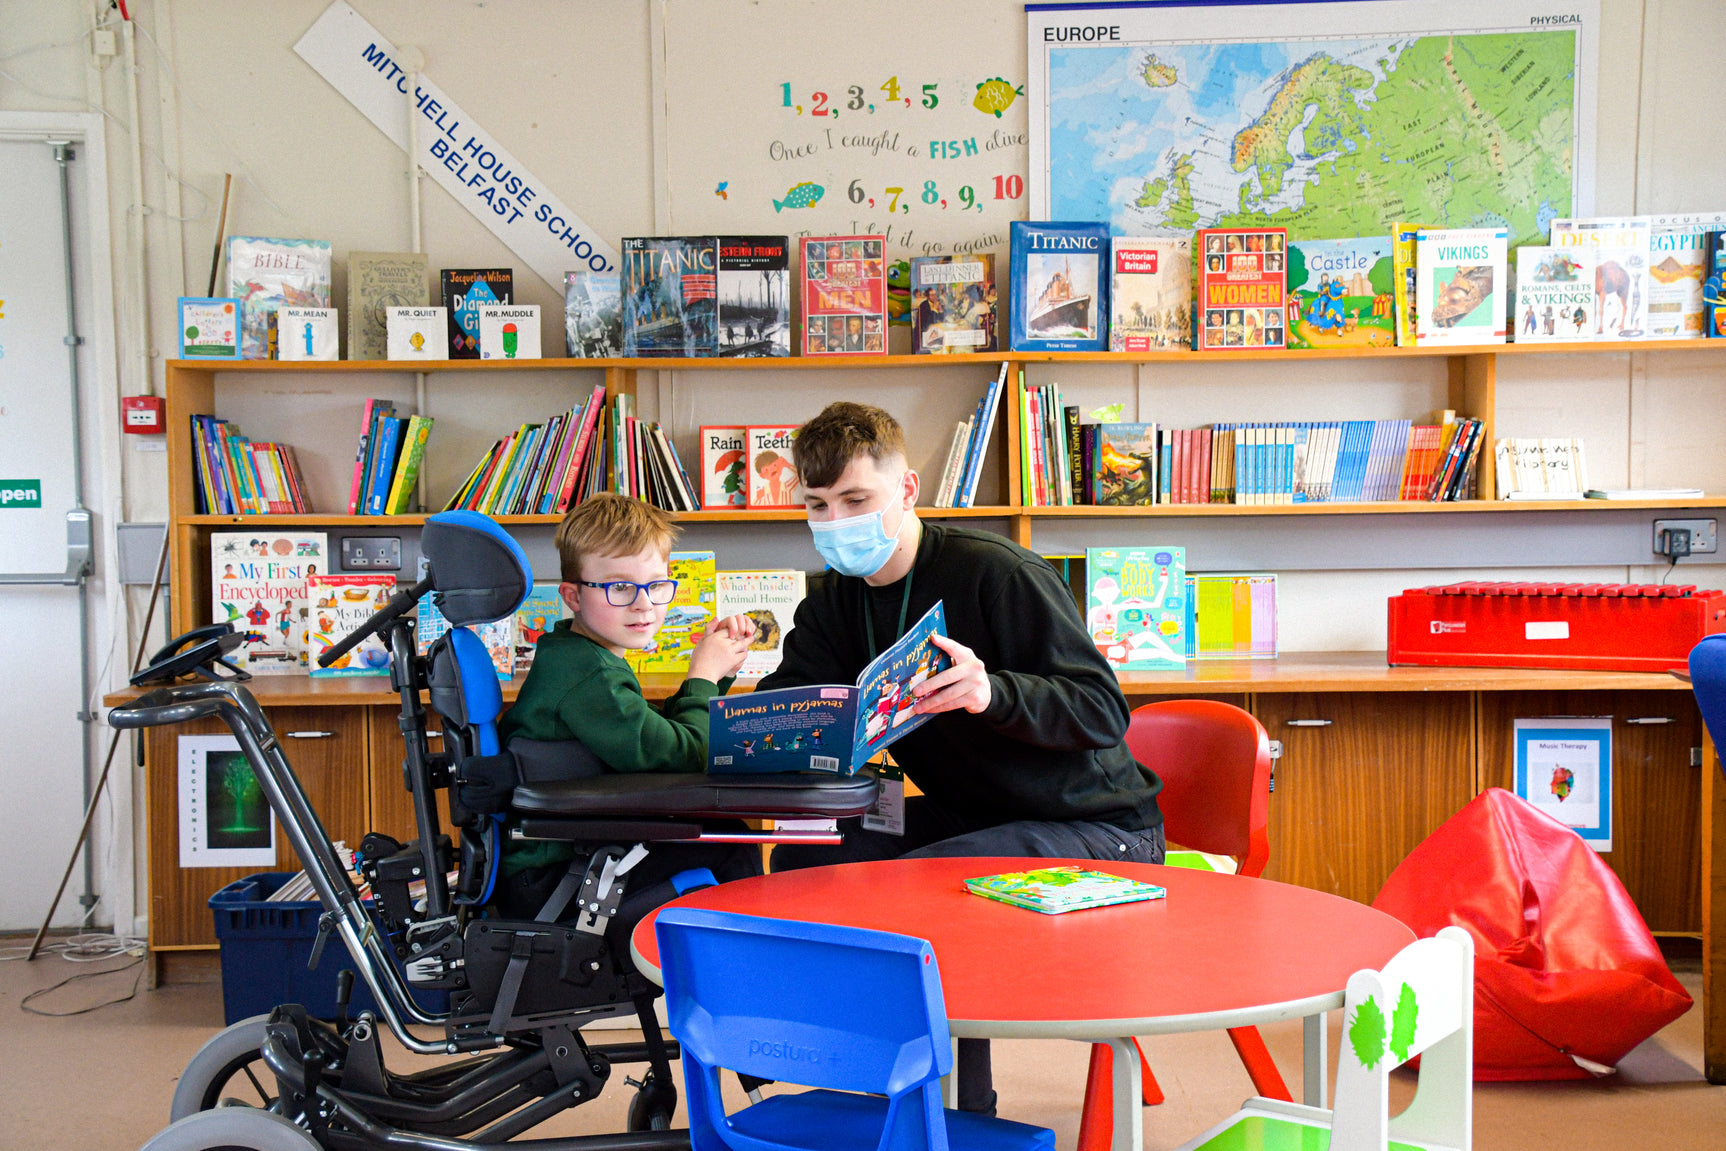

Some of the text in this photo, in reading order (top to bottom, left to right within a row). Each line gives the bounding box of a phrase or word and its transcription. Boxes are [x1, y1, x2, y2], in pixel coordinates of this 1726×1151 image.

[1530, 14, 1582, 25] PHYSICAL
[1044, 26, 1120, 42] EUROPE
[811, 91, 839, 119] 2,
[847, 85, 875, 114] 3,
[880, 76, 911, 108] 4,
[921, 83, 939, 110] 5
[769, 128, 1029, 161] Once I caught a FISH alive
[429, 138, 524, 224] BELFAST
[992, 174, 1024, 201] 10
[462, 137, 536, 207] HOUSE
[534, 204, 614, 272] SCHOO
[1652, 216, 1701, 225] OCUS
[623, 239, 644, 248] THE
[900, 229, 915, 249] it
[922, 240, 944, 257] go
[1028, 232, 1099, 250] TITANIC
[1561, 232, 1639, 247] DESERT
[719, 246, 783, 257] ESTERN FRONT
[1119, 252, 1156, 261] Victorian
[1437, 245, 1489, 261] VIKINGS
[254, 252, 305, 270] BIBLE
[1124, 261, 1151, 270] Britain
[1232, 255, 1258, 273] 100
[1310, 250, 1367, 272] Castle
[450, 271, 511, 286] Jacqueline Wilson
[625, 248, 715, 294] TITANIC
[832, 263, 857, 279] 100
[931, 271, 981, 283] TITANIC
[1226, 271, 1262, 281] GREATEST
[473, 288, 488, 298] The
[1209, 284, 1281, 304] WOMEN
[1521, 283, 1592, 293] ROMANS, CELTS
[819, 290, 871, 309] MEN
[1521, 293, 1592, 305] & VIKINGS
[287, 310, 328, 318] MR. MEAN
[485, 310, 534, 318] MR. MUDDLE
[710, 436, 742, 450] Rain
[755, 435, 794, 449] Teeth
[1071, 427, 1082, 482] HARRY POTTER
[239, 562, 302, 585] My First
[1120, 567, 1155, 585] BODY
[219, 581, 309, 605] Encycloped
[674, 587, 691, 596] ood
[721, 581, 755, 591] What's
[1121, 584, 1155, 597] WORKS
[722, 594, 793, 603] Animal Homes
[863, 626, 938, 700] Llamas in pyjamas
[725, 699, 844, 720] Llamas in pyjamas
[748, 1039, 820, 1063] postura
